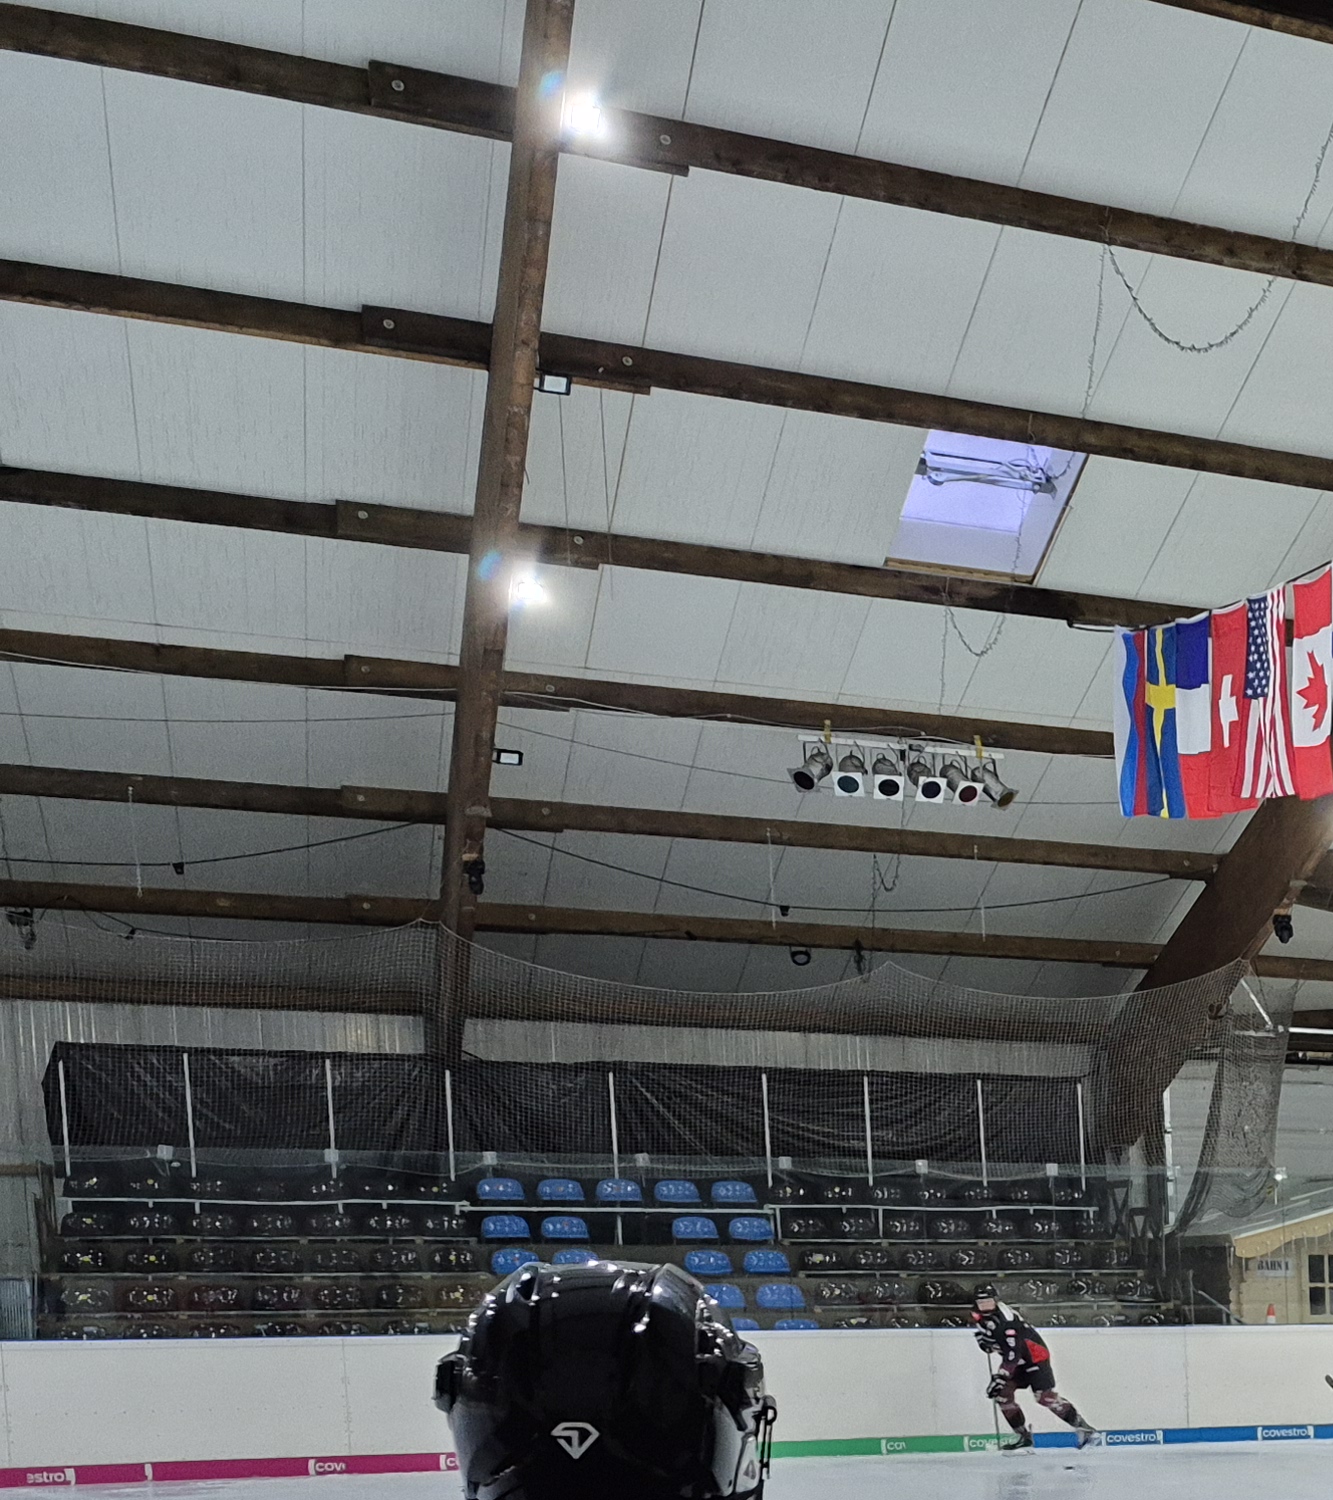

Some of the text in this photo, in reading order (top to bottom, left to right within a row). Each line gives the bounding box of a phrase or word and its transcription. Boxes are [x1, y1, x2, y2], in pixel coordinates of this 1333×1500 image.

[1257, 1259, 1282, 1272] BAHN
[1106, 1431, 1157, 1445] covestro
[1261, 1426, 1309, 1440] covestro
